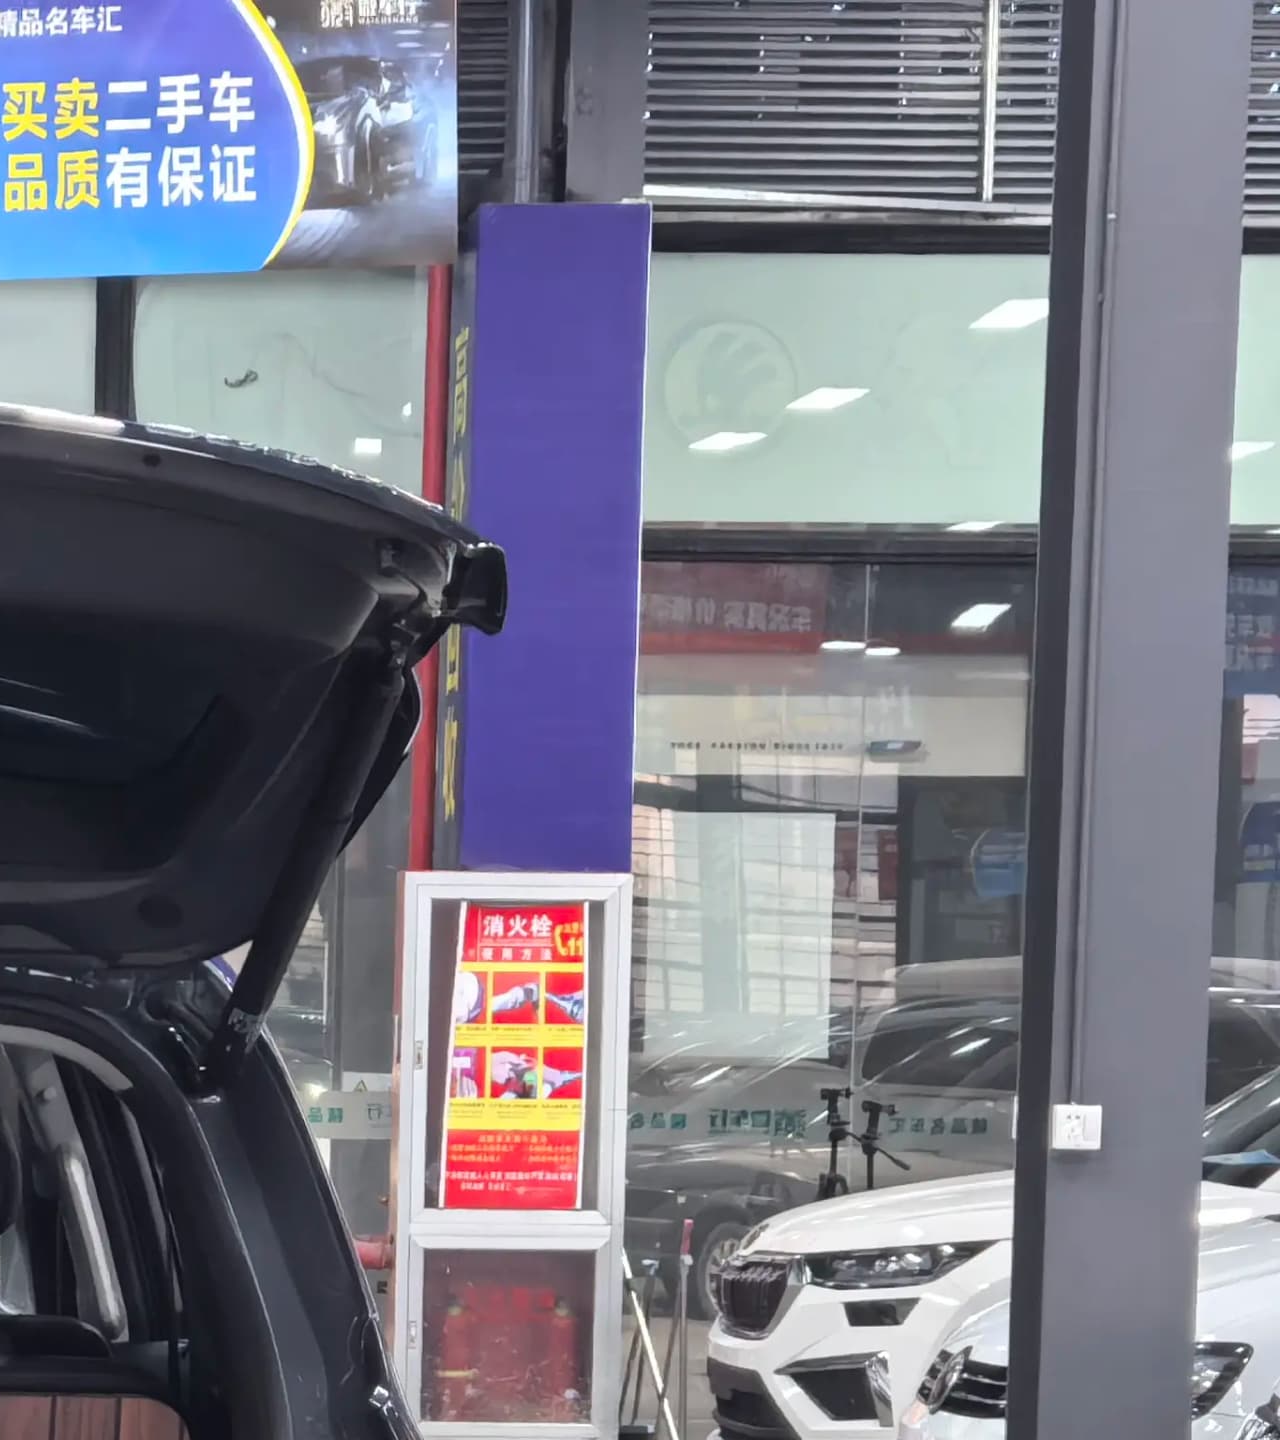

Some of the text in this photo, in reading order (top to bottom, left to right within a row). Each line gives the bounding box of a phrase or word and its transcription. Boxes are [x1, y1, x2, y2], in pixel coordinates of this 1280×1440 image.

[1, 71, 256, 142] 买卖二手车
[3, 144, 258, 213] 品质有保证
[483, 914, 553, 938] 消火栓
